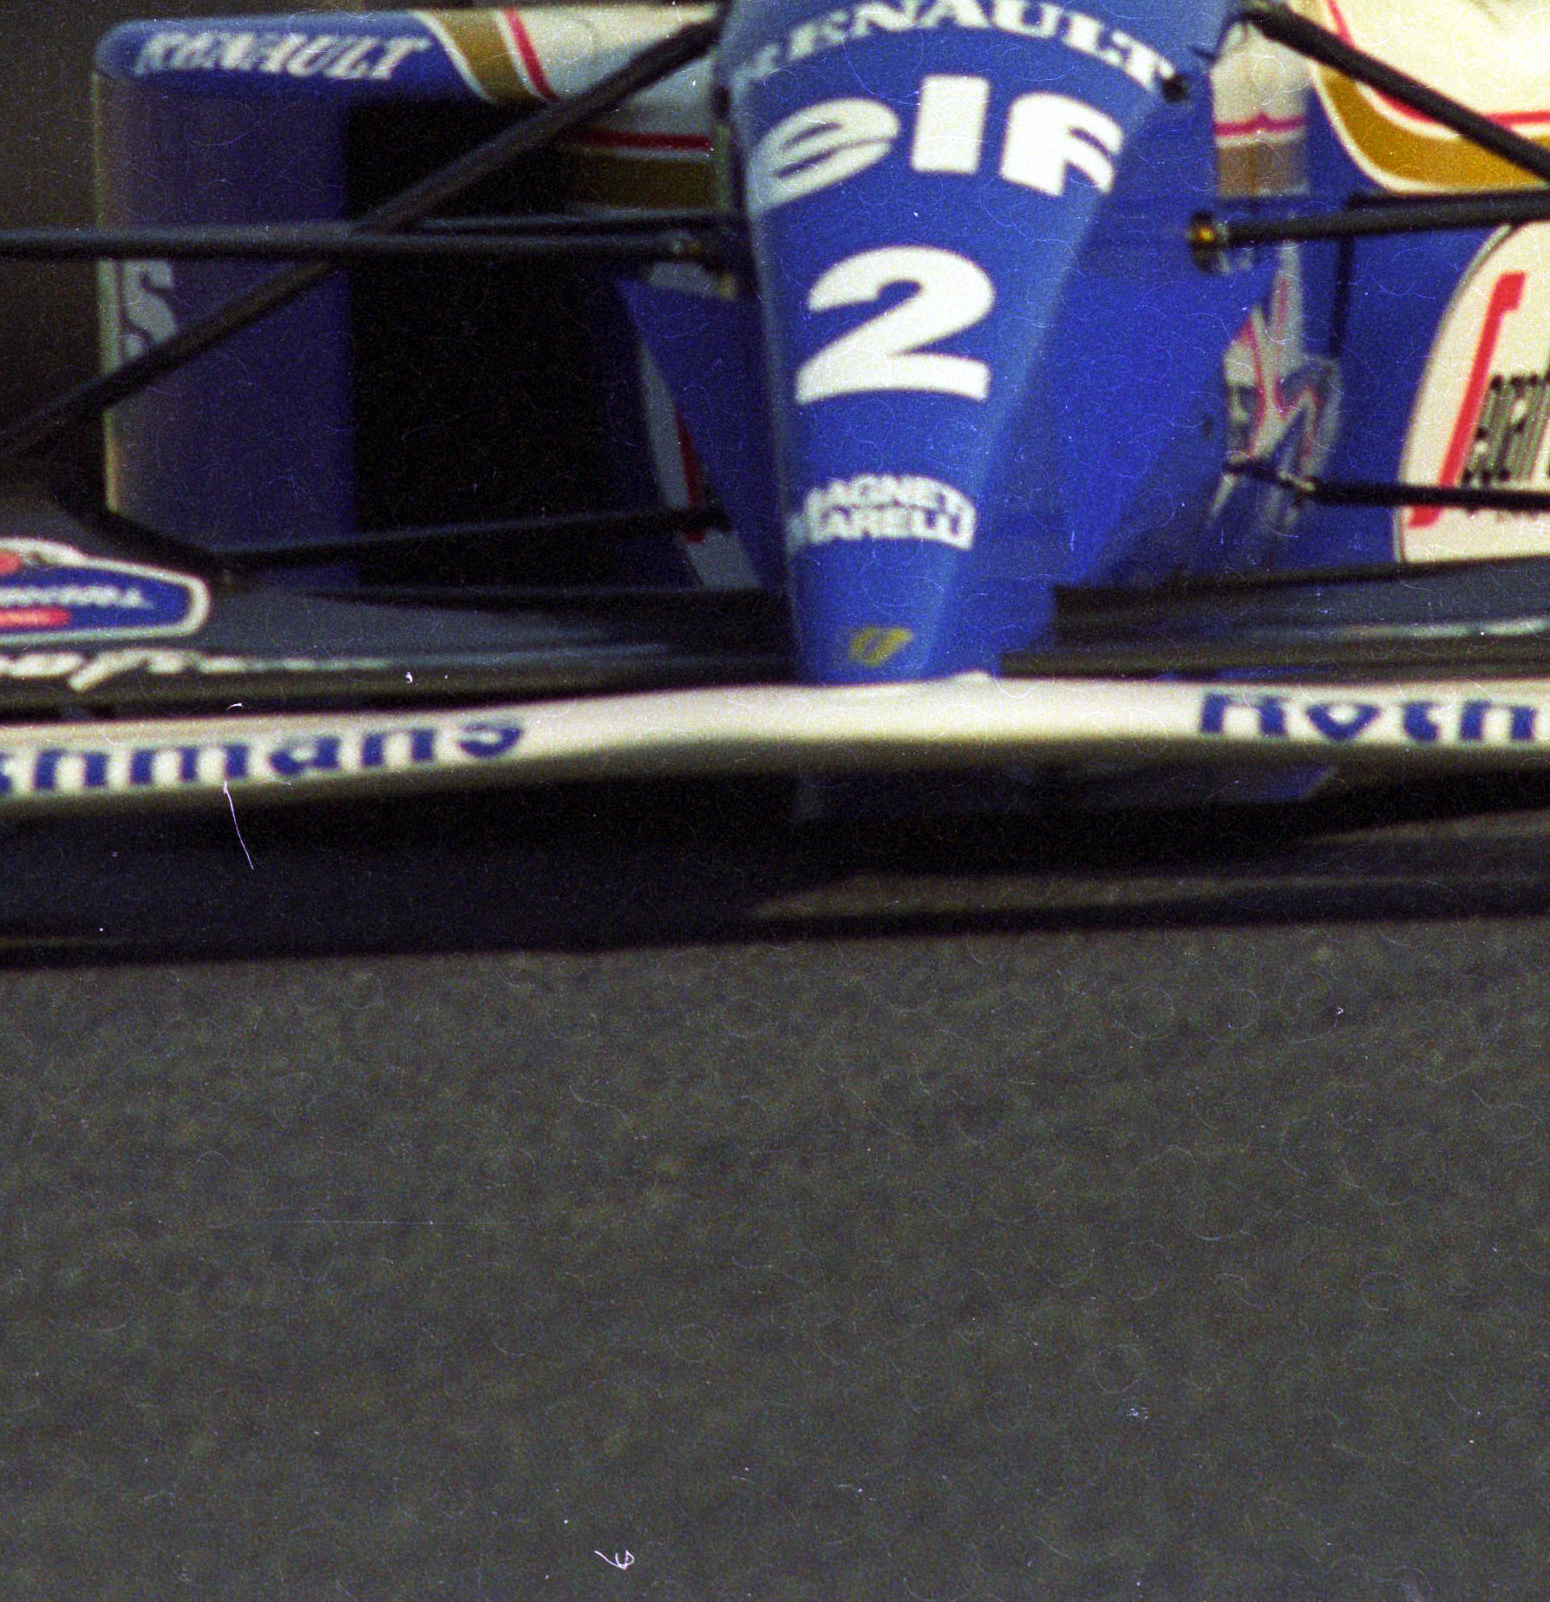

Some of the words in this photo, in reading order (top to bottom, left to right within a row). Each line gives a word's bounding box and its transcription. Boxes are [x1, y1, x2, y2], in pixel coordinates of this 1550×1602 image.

[134, 31, 432, 80] RENAULT
[747, 75, 1124, 210] elf
[795, 245, 997, 404] 2
